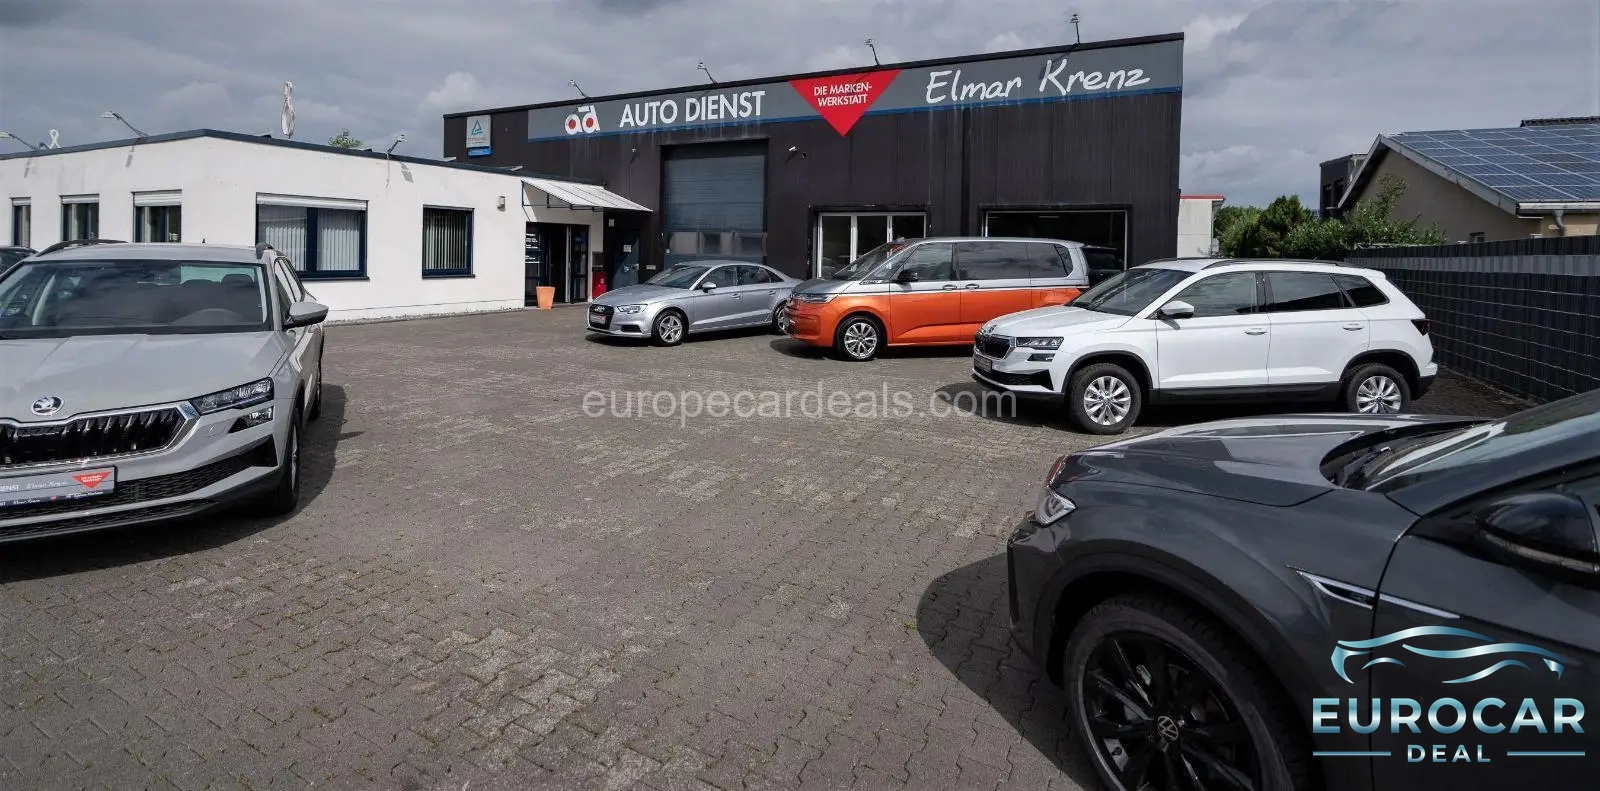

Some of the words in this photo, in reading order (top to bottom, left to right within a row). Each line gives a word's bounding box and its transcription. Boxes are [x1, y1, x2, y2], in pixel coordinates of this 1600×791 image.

[813, 85, 828, 96] DIE
[829, 81, 873, 95] MARKEN-
[925, 69, 1022, 104] Elmar
[1038, 58, 1152, 97] Krenz
[619, 99, 678, 128] AUTO
[685, 90, 766, 122] DIENST
[817, 93, 868, 107] WERKSTATT
